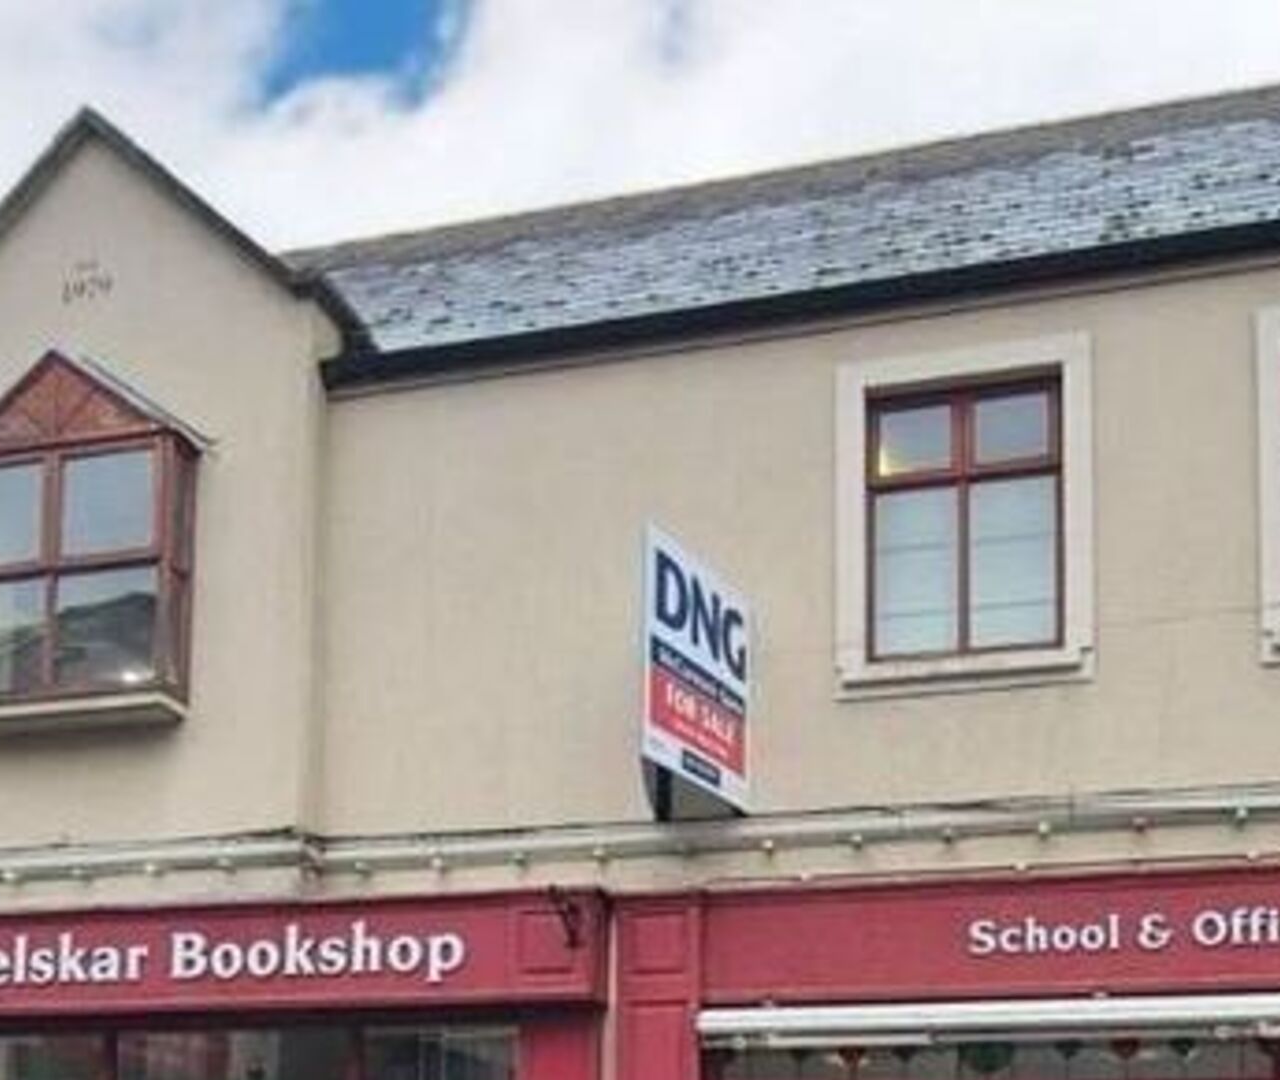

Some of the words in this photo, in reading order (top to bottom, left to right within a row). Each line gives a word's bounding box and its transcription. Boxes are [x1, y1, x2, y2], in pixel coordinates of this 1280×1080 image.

[656, 549, 747, 682] DNG
[168, 920, 465, 982] Bookshop
[968, 914, 1120, 954] School
[1138, 914, 1171, 948] &
